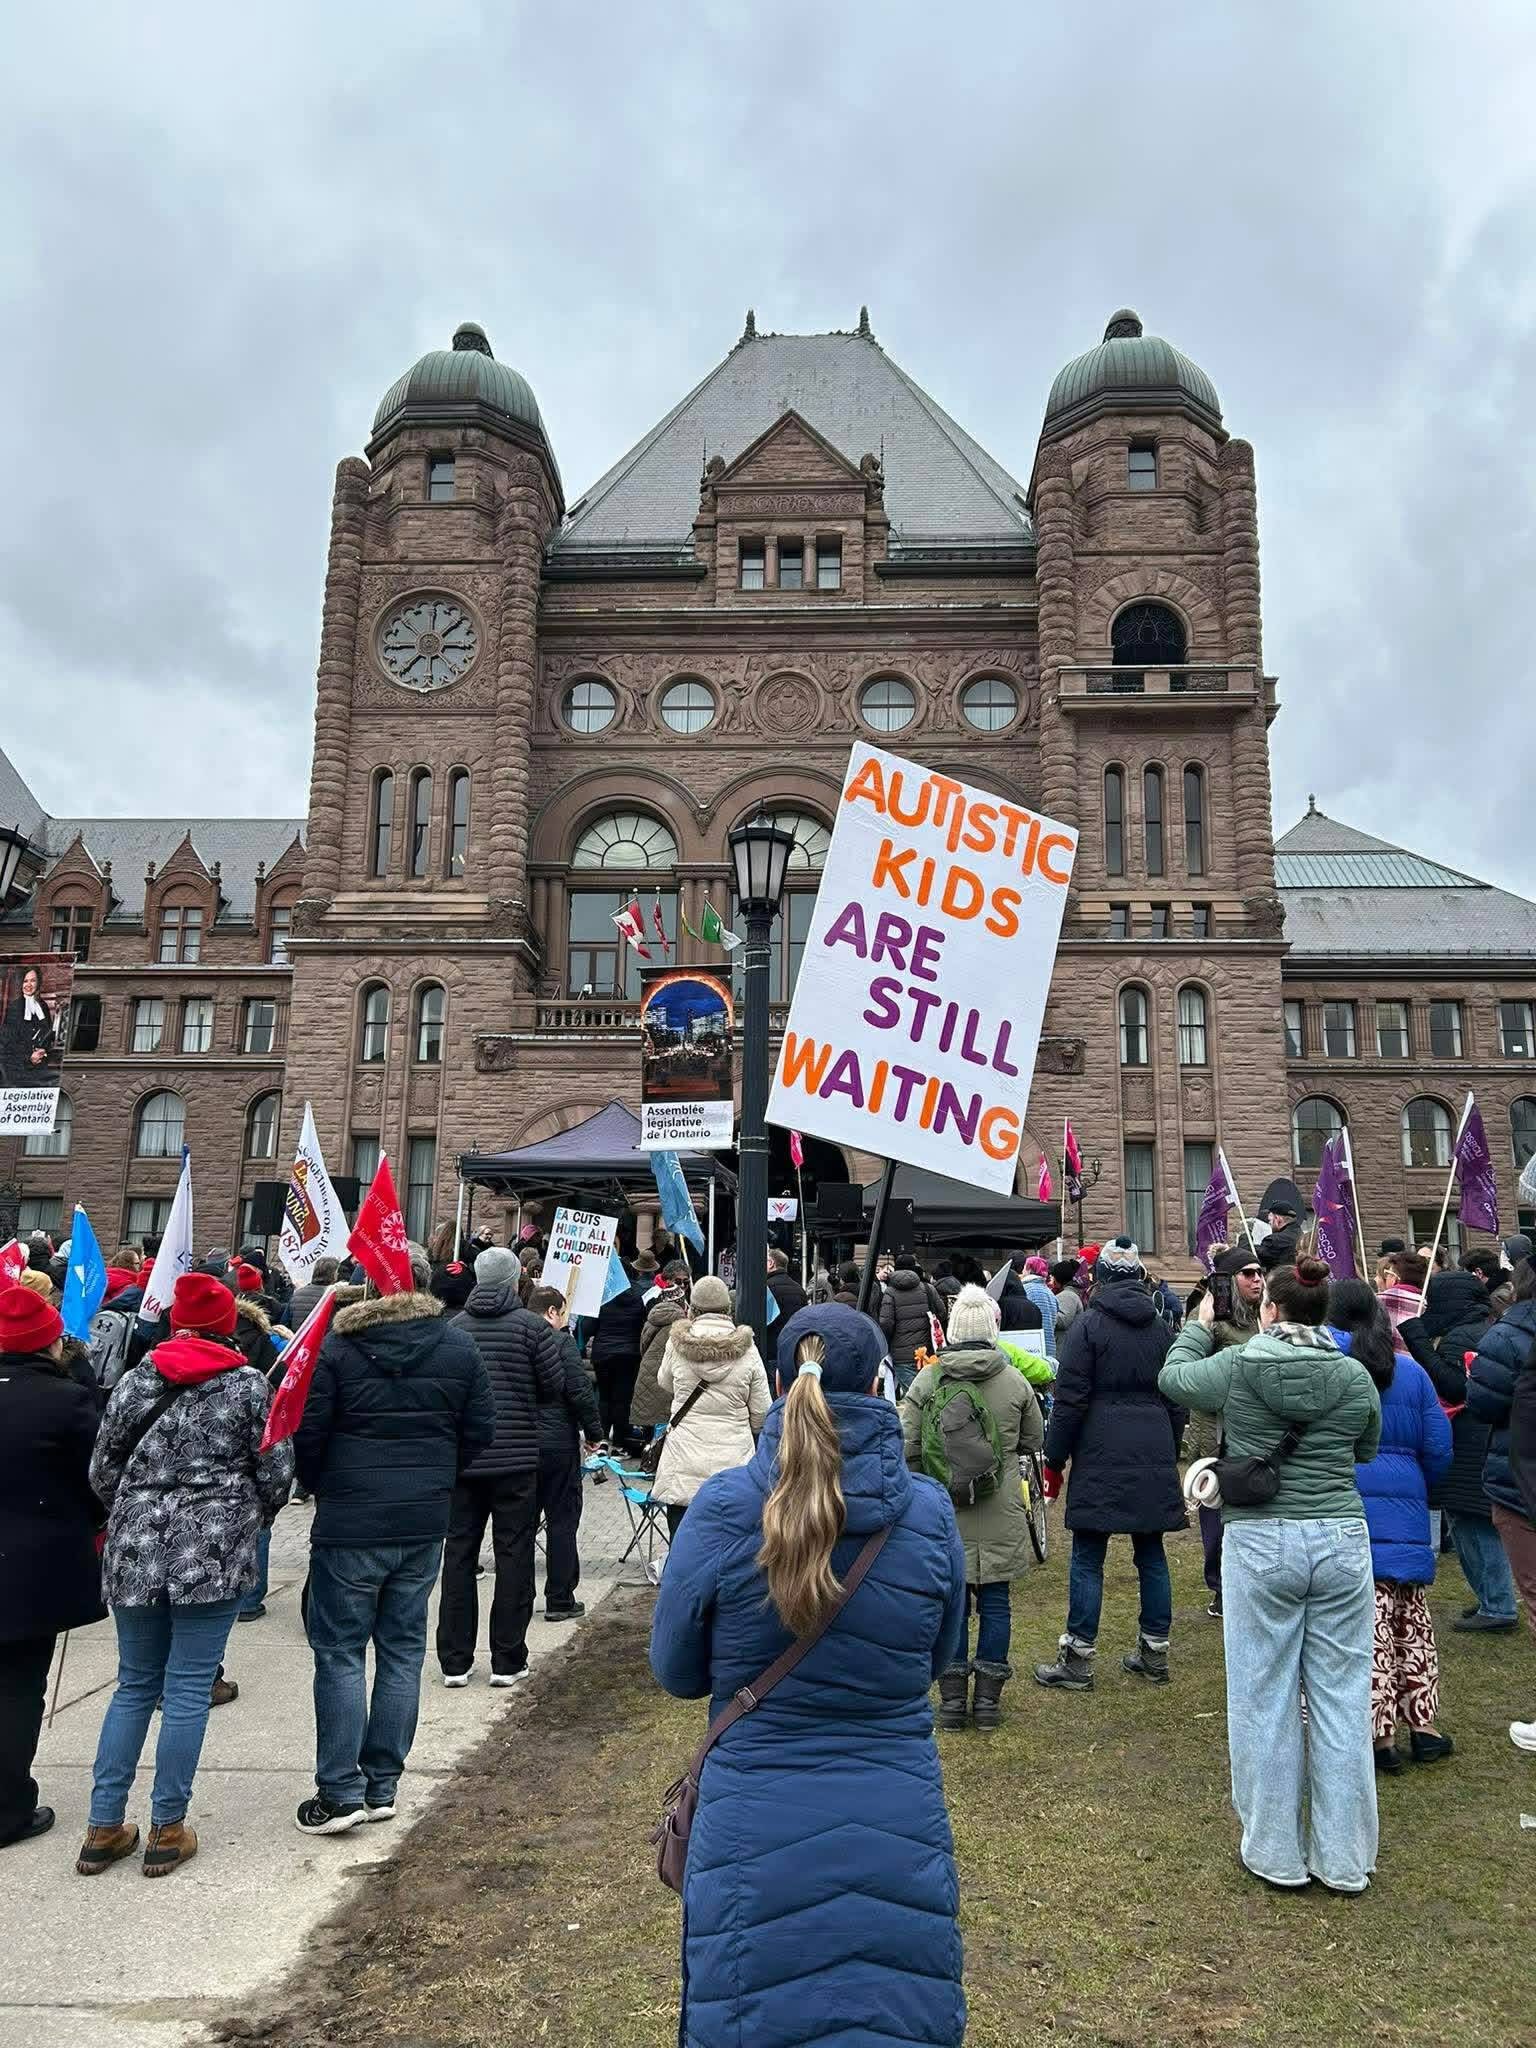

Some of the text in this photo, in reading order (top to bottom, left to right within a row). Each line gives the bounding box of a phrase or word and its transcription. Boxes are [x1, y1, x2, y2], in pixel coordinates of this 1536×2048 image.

[844, 757, 1075, 885] AUTISTIC
[872, 838, 1022, 938] KIDS
[823, 901, 946, 982] ARE
[862, 976, 1019, 1078] STILL
[3, 1091, 54, 1102] Legislative
[780, 1032, 1020, 1161] WAITING
[5, 1103, 52, 1114] Assembly
[647, 1104, 705, 1116] Assemblée
[0, 1113, 51, 1124] of Ontario
[647, 1117, 702, 1130] législative
[646, 1129, 711, 1139] de l'Ontario
[556, 1208, 601, 1226] EA CUTS
[556, 1223, 607, 1242] HURT ALL
[299, 1236, 329, 1269] JUSTIC
[556, 1237, 611, 1259] CHILDREN!
[553, 1250, 583, 1265] #OAC
